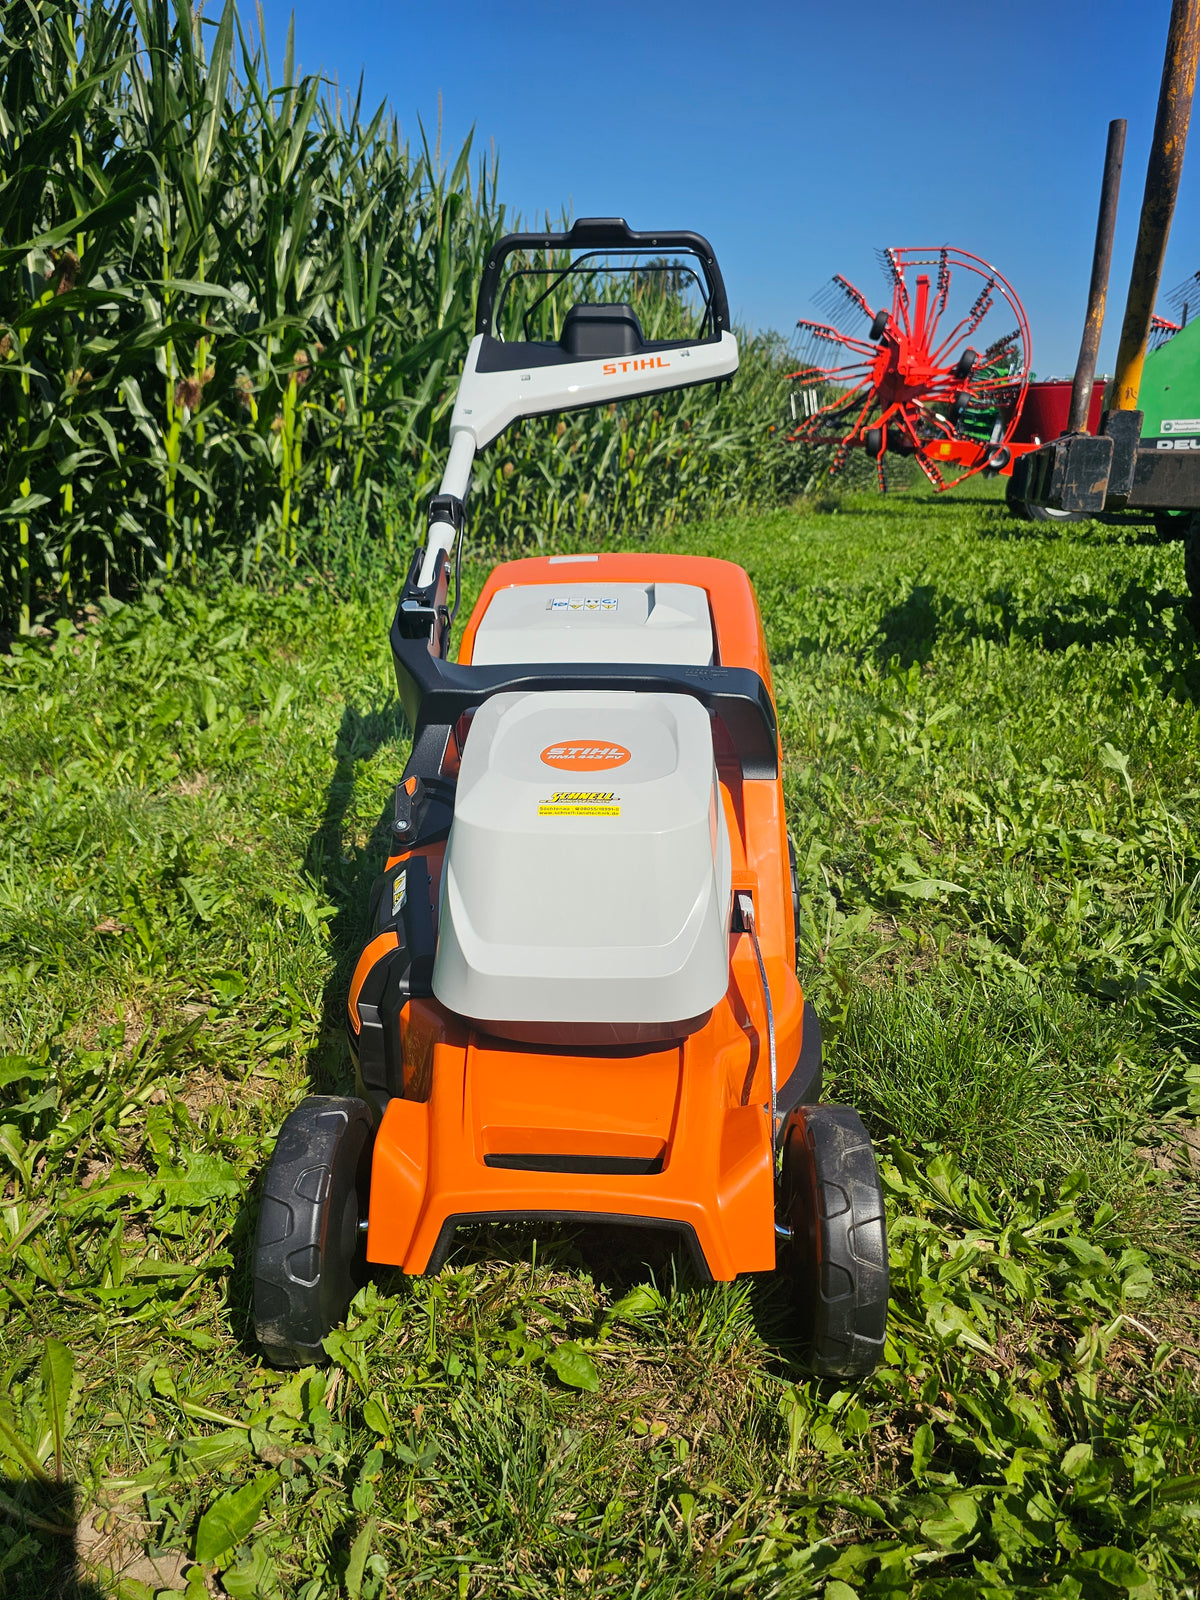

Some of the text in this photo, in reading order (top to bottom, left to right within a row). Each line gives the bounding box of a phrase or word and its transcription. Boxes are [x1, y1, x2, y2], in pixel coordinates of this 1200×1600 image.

[603, 357, 670, 375] STIHL
[547, 747, 625, 755] STIHL
[551, 792, 615, 803] SCHNELL
